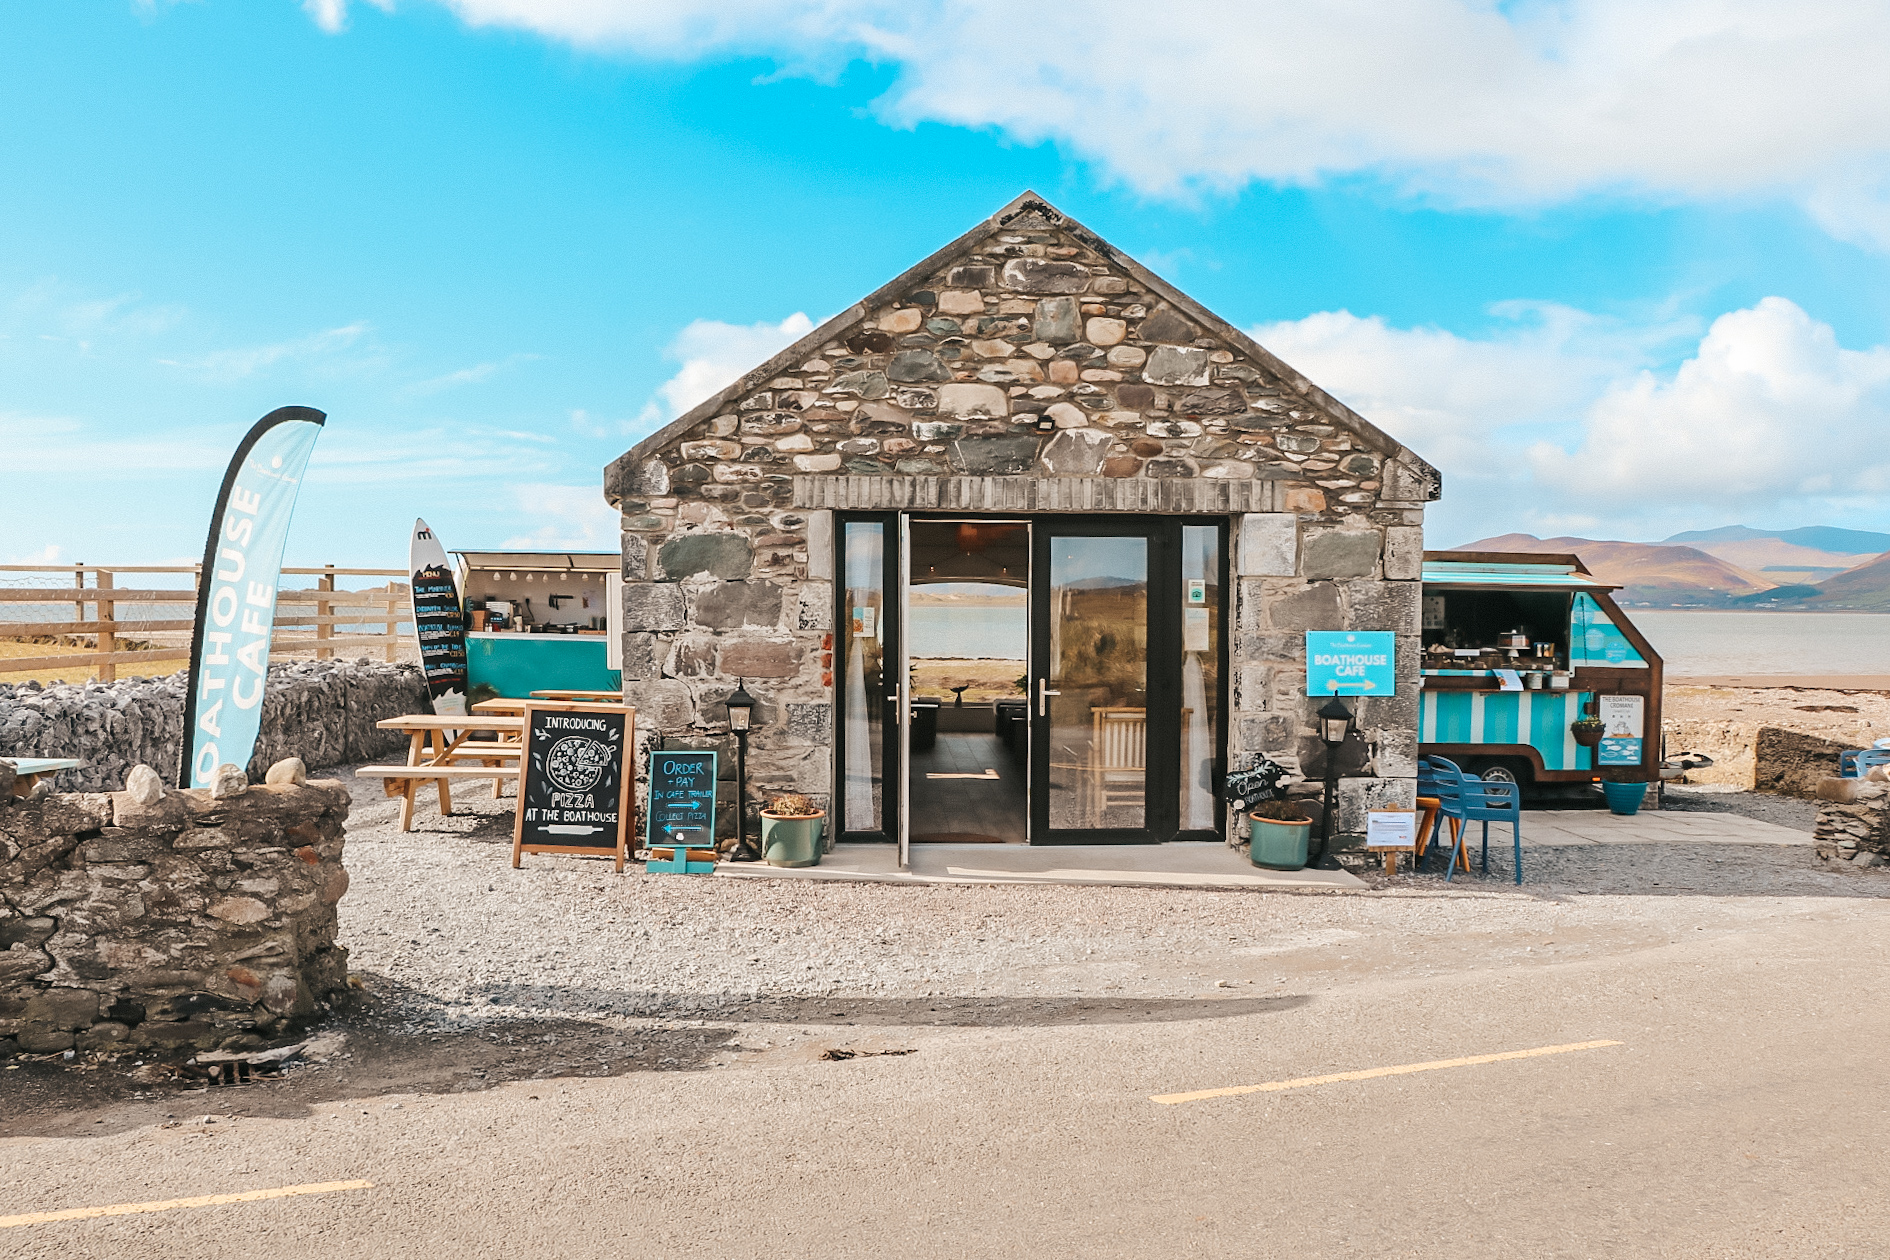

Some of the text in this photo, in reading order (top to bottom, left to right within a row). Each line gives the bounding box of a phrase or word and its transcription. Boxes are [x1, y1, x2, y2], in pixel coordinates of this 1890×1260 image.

[196, 485, 261, 784] OATHOUSE
[232, 581, 273, 710] CAFE
[1314, 654, 1387, 666] BOATHOUSE
[1335, 665, 1365, 676] CAFE
[544, 716, 607, 732] INTRODUCING
[663, 760, 705, 775] ORDER
[675, 777, 695, 788] PAY
[551, 792, 595, 808] PIZZA
[654, 790, 664, 800] IN
[666, 790, 684, 799] CAFE
[525, 808, 618, 823] AT THE BOATHOUSE
